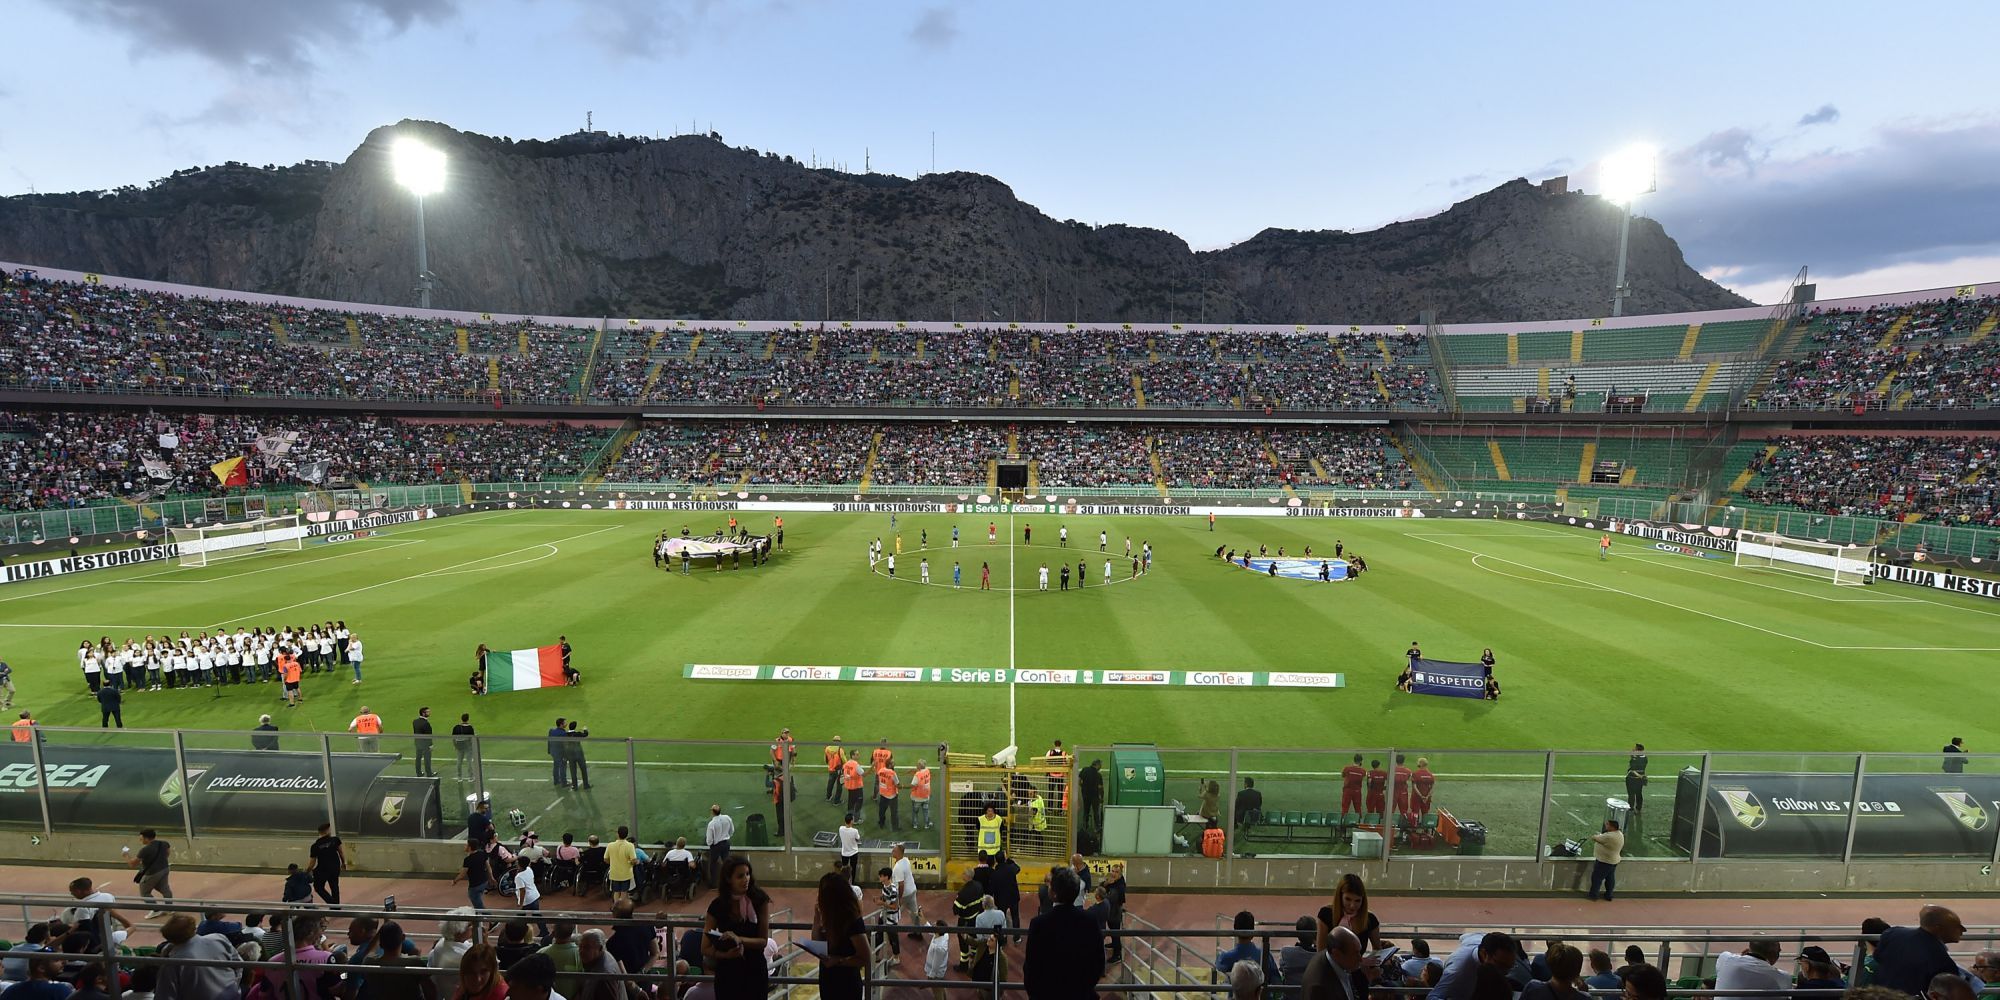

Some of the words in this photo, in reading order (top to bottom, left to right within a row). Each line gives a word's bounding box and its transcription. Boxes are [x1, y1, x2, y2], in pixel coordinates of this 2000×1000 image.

[630, 501, 643, 509] 30
[647, 501, 669, 509] ILIJA
[672, 501, 738, 510] NESTOROVSKI
[832, 503, 846, 512] 30
[849, 503, 870, 512] ILIJA
[874, 503, 941, 512] NESTOROVSKI
[975, 503, 999, 513] Serie
[1000, 504, 1008, 513] B
[1080, 505, 1094, 514] 30
[1098, 505, 1120, 514] ILIJA
[1123, 506, 1190, 515] NESTOROVSKI
[1286, 507, 1299, 516] 30
[1302, 508, 1324, 516] ILIJA
[1329, 508, 1396, 517] NESTOROVSKI
[306, 524, 321, 536] 30
[324, 521, 349, 534] ILIJA
[352, 511, 414, 530] NESTOROVSKI
[1628, 525, 1640, 536] 30
[1642, 527, 1663, 540] ILIJA
[1666, 530, 1737, 552] NESTOROVSKI
[7, 563, 55, 581] ILIJA
[60, 543, 179, 573] NESTOROVSKI
[1869, 563, 1891, 578] 30
[1896, 567, 1936, 587] ILIJA
[712, 666, 752, 677] Kappa
[781, 667, 831, 679] ConTe.it
[861, 669, 875, 678] sky
[876, 670, 902, 678] SPORT
[951, 668, 991, 682] Serie
[994, 668, 1006, 682] B
[1020, 670, 1072, 682] ConTe.it
[1109, 673, 1122, 681] sky
[1124, 673, 1151, 681] SPORT
[1193, 672, 1245, 684] ConTe.it
[1289, 674, 1330, 684] Kappa
[1428, 675, 1484, 687] RISPETTO
[0, 763, 111, 787] EGEA
[1772, 797, 1819, 811] follow
[1821, 800, 1841, 811] us
[912, 861, 924, 870] 1B
[926, 861, 937, 870] 1A
[1093, 864, 1104, 872] 1E
